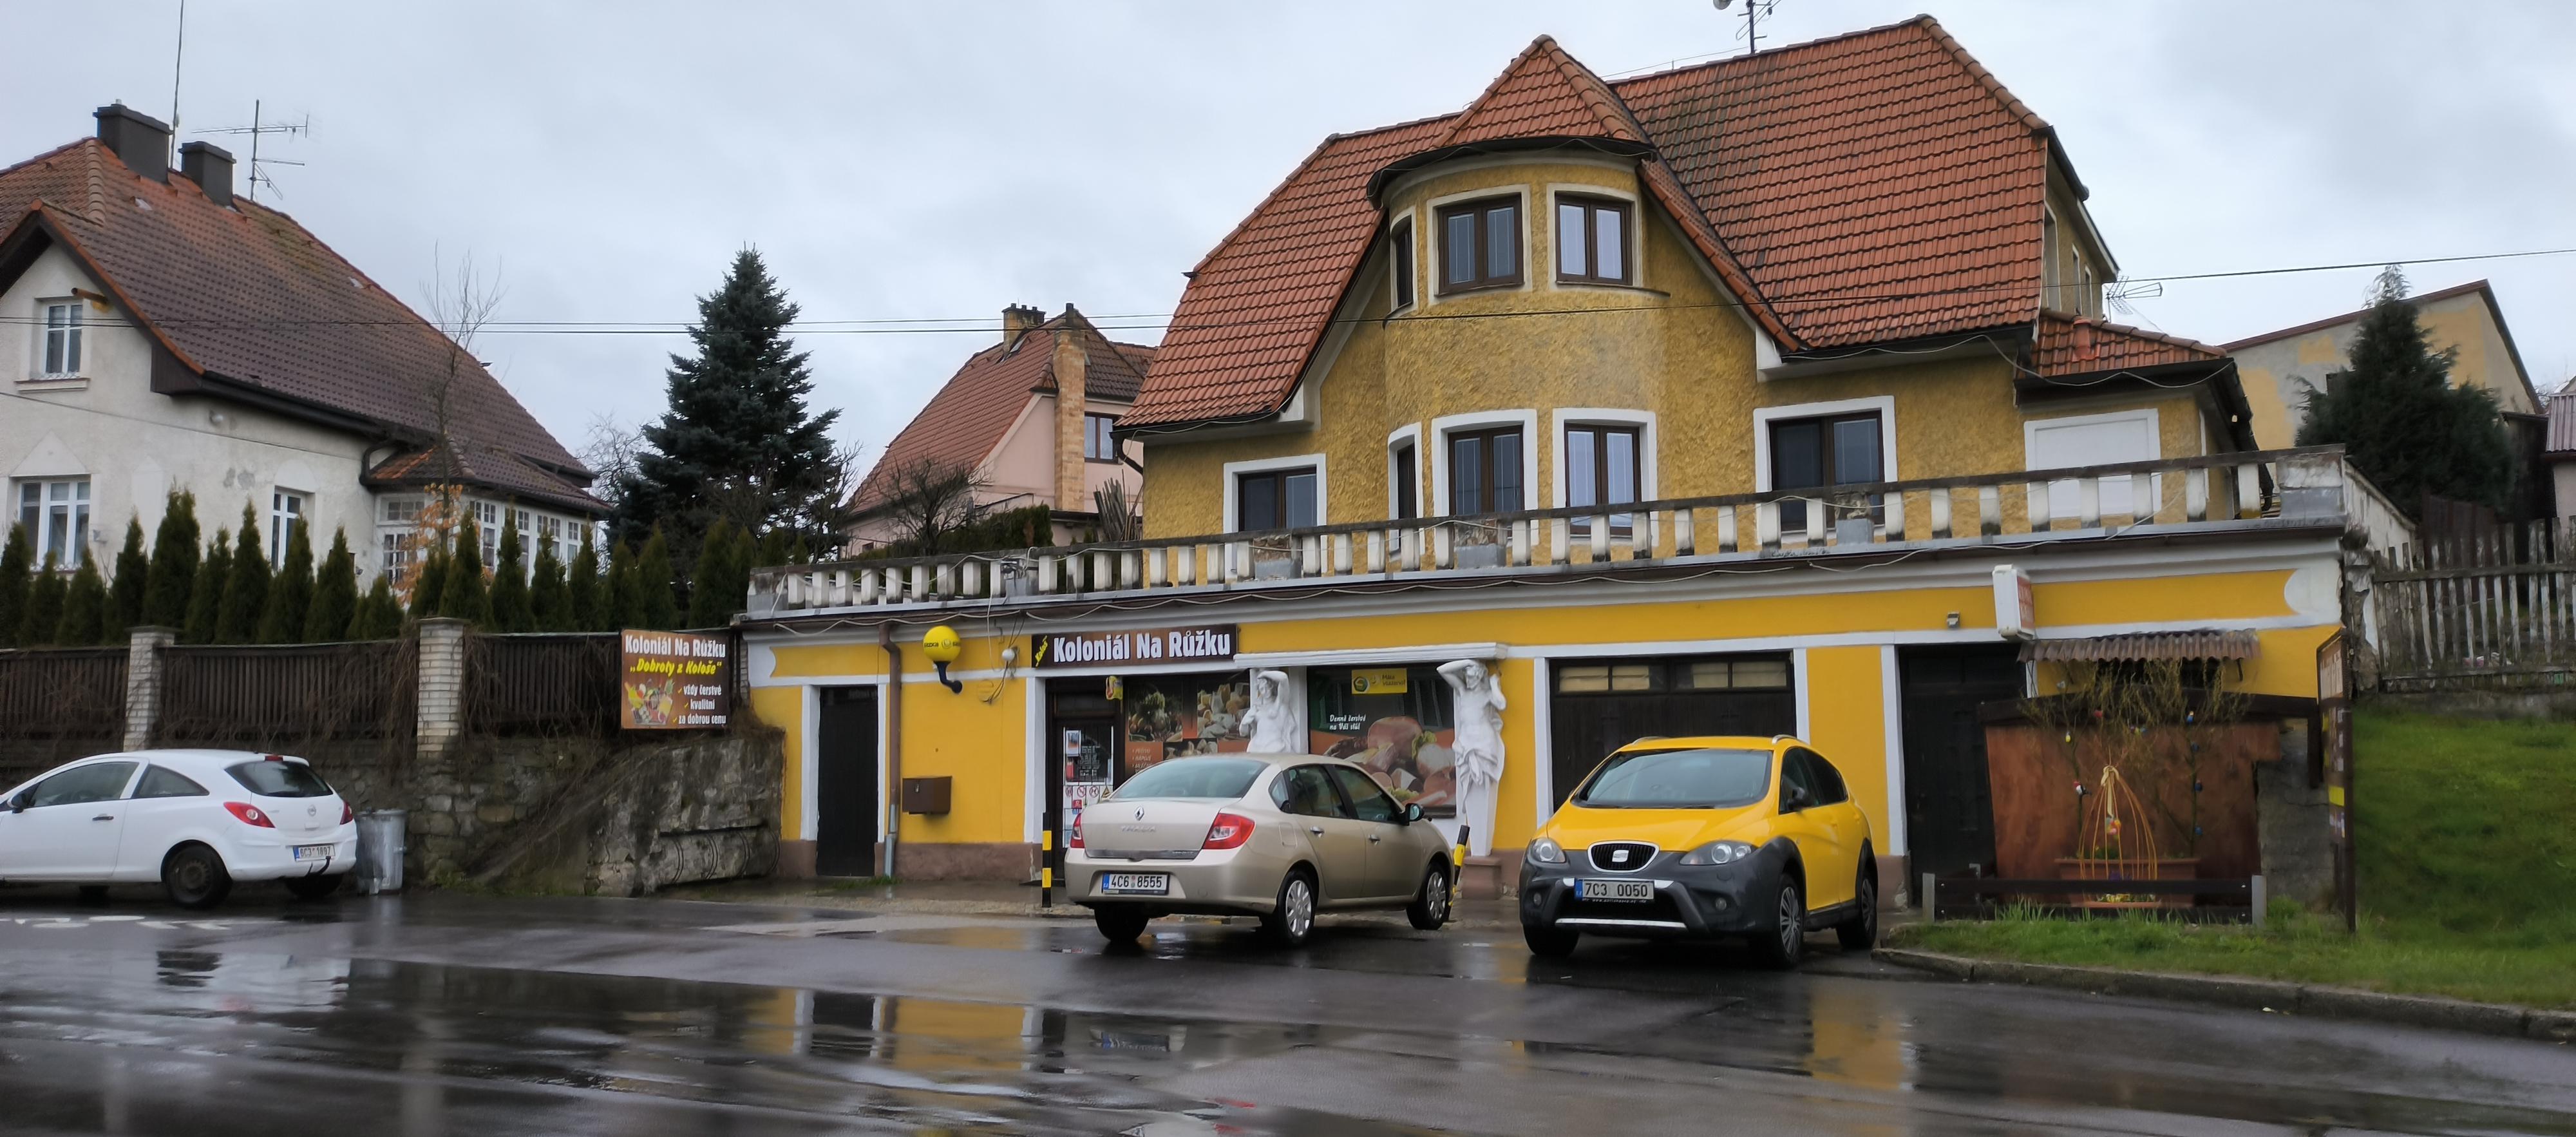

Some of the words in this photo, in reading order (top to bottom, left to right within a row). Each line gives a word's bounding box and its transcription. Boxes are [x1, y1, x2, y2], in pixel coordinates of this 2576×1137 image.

[625, 635, 671, 655] Koloniál
[675, 638, 689, 656] Na
[693, 639, 726, 658] Růžku
[1054, 634, 1130, 662] Koloniál
[1137, 633, 1162, 658] Na
[1169, 629, 1231, 658] Růžku
[677, 664, 683, 673] z
[683, 684, 698, 696] vždy
[699, 684, 721, 696] čerstvé
[690, 698, 715, 710] kvalitní
[679, 715, 686, 724] za
[687, 713, 710, 724] dobrou
[711, 715, 726, 724] cenu
[1111, 875, 1130, 888] 4C6
[1137, 875, 1162, 888] 8555
[1585, 883, 1607, 896] 7C3
[1617, 884, 1648, 897] 0050
